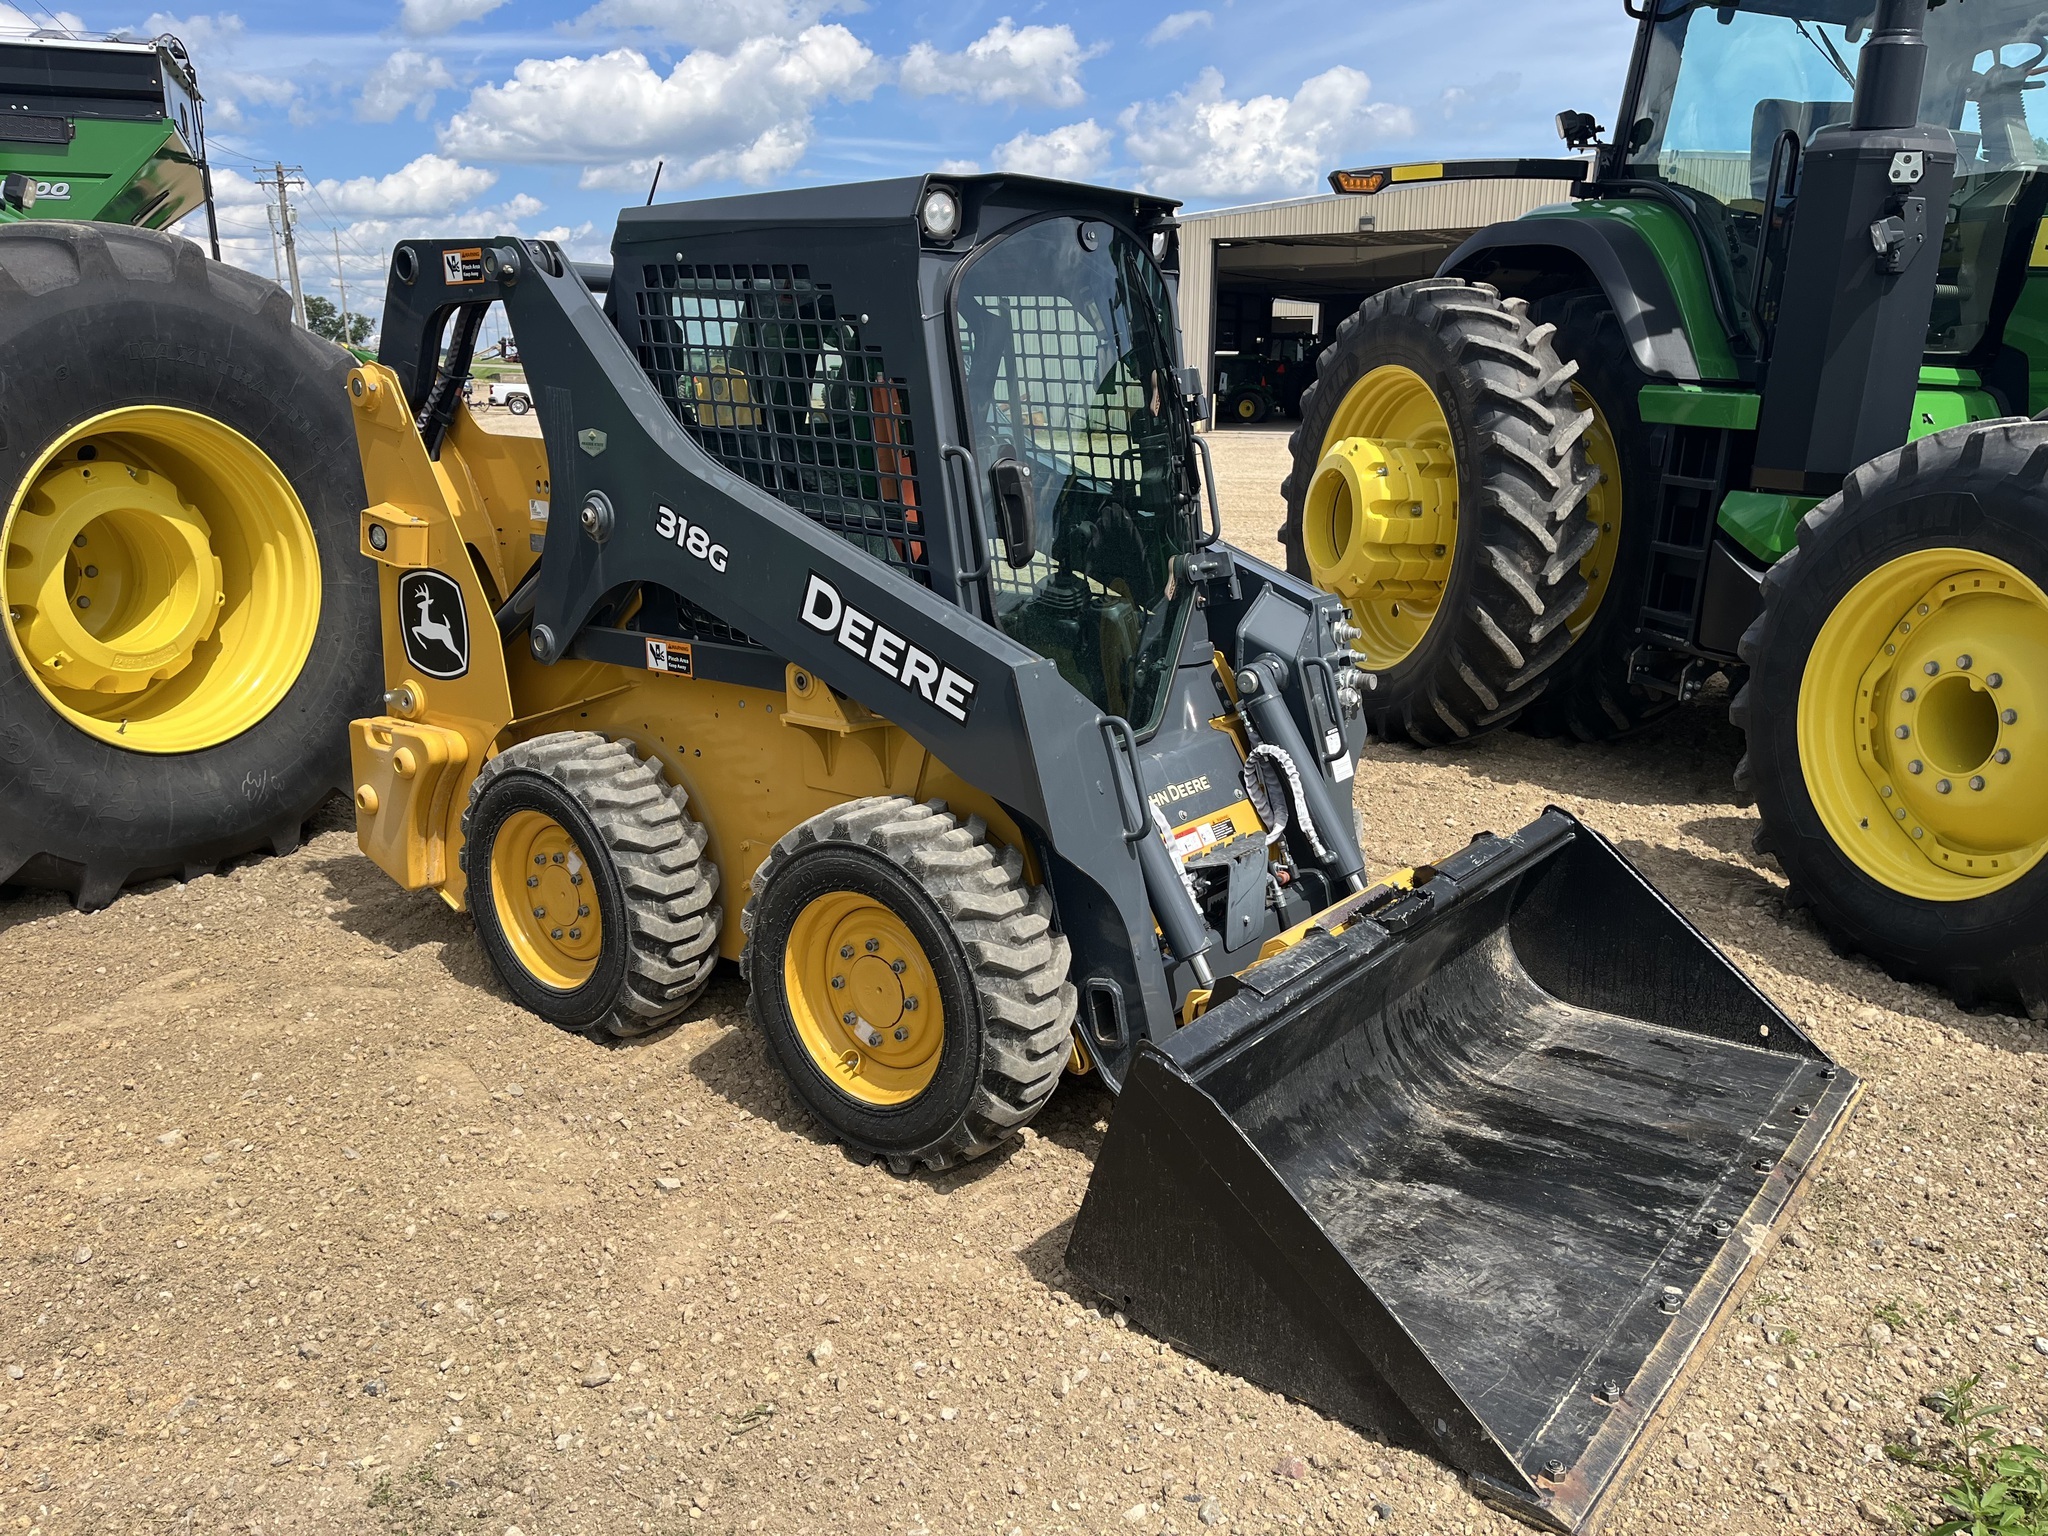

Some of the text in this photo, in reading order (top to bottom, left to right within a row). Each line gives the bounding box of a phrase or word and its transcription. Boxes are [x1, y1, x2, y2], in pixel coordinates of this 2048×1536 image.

[655, 504, 730, 573] 318G
[801, 574, 974, 722] DEERE
[1148, 775, 1211, 807] HN DEERE
